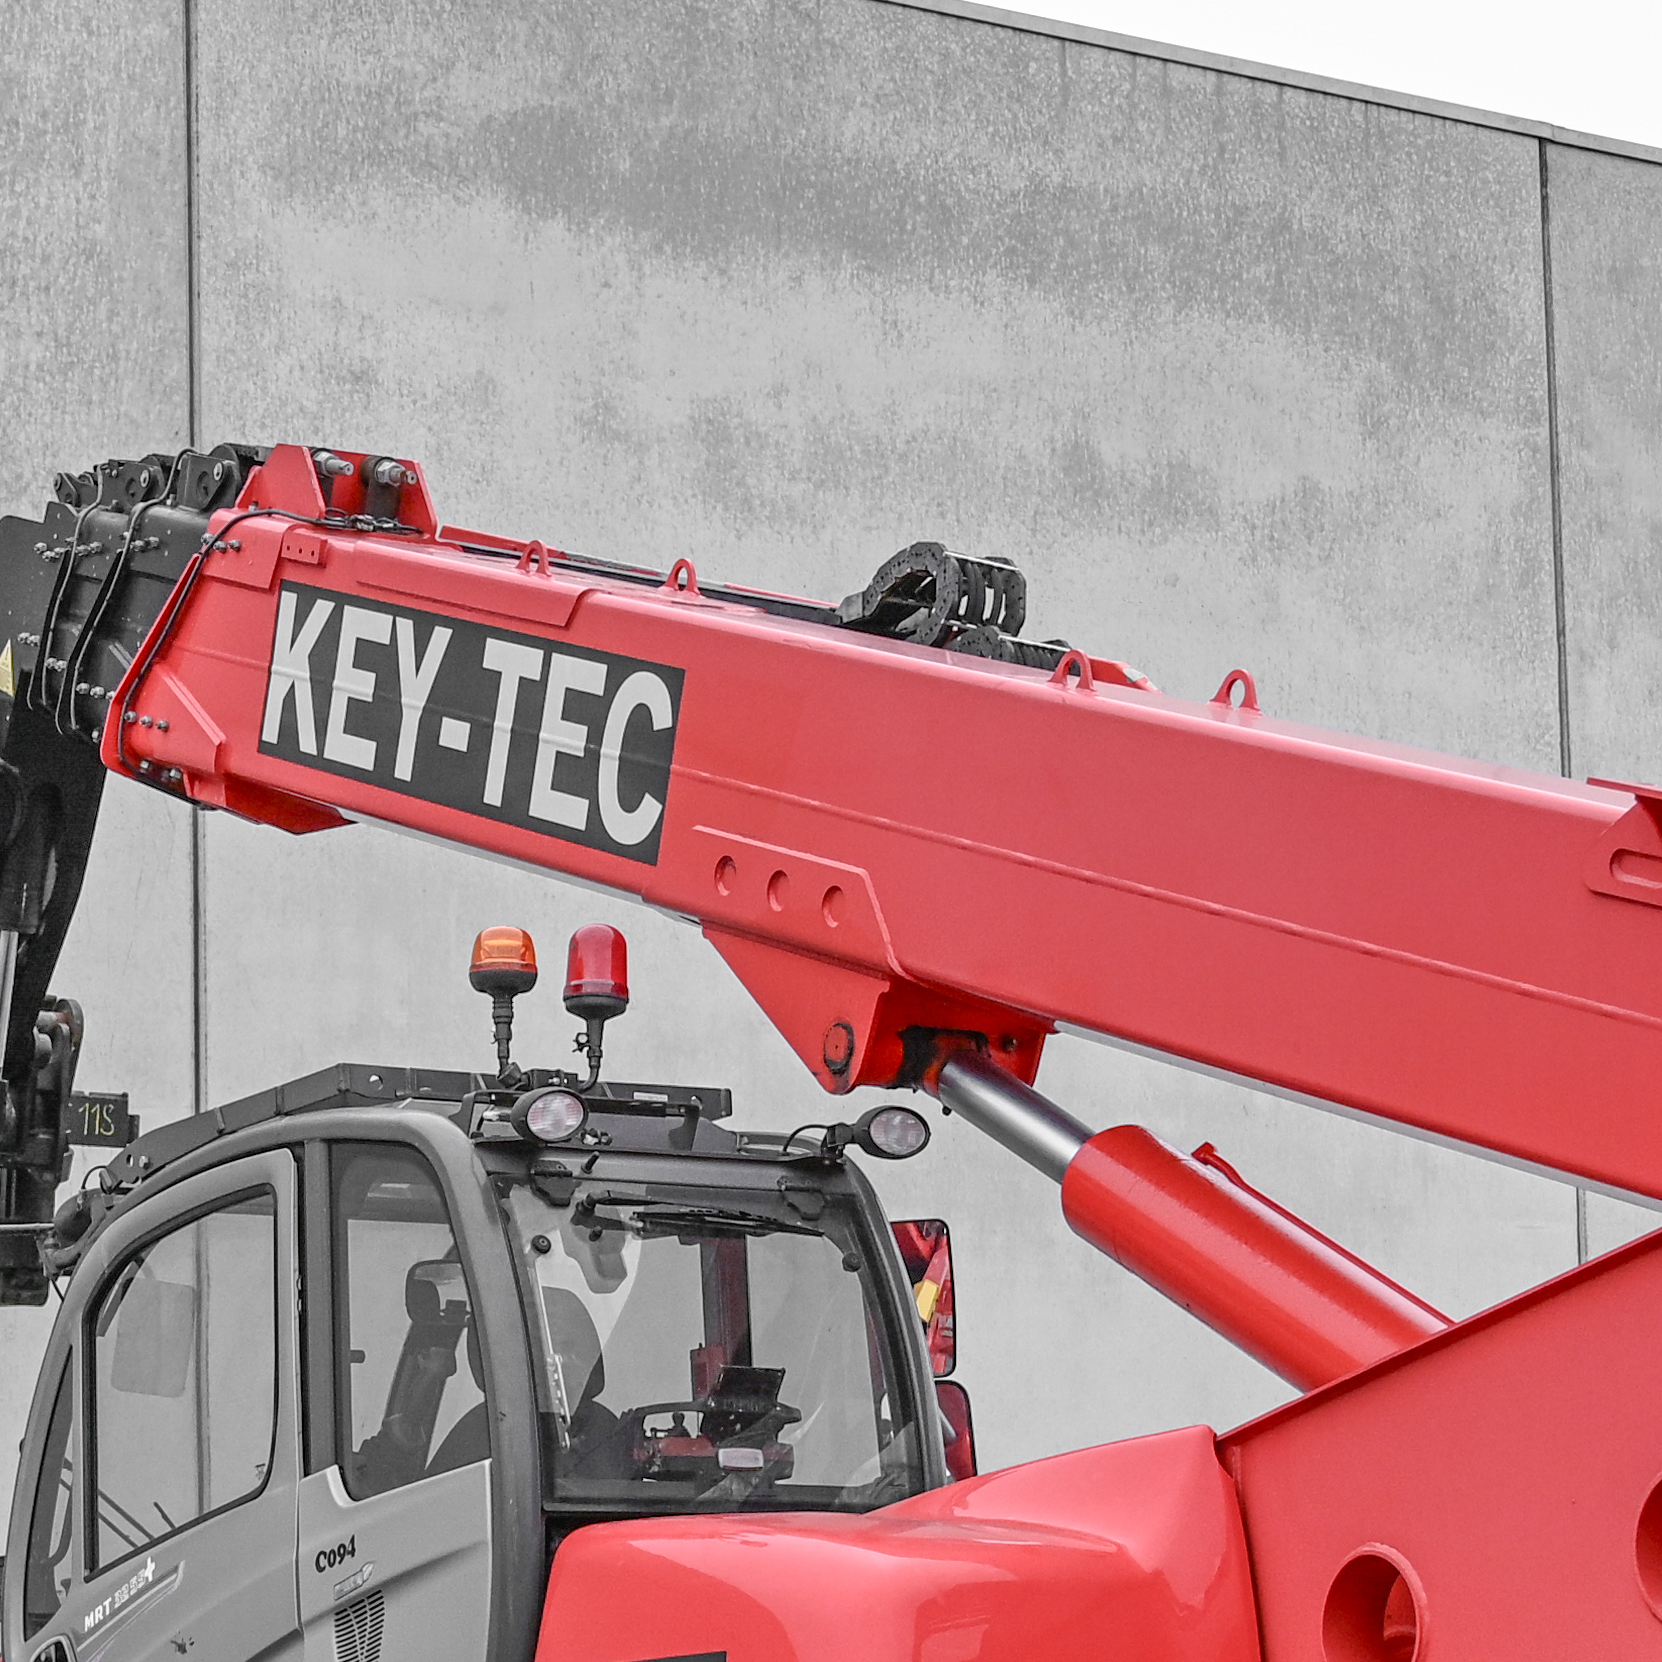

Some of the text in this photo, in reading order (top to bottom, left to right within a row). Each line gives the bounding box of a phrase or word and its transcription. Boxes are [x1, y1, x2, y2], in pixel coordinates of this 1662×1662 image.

[261, 591, 673, 846] KEY-TEC
[315, 1533, 356, 1573] C094
[84, 1597, 112, 1632] MRT
